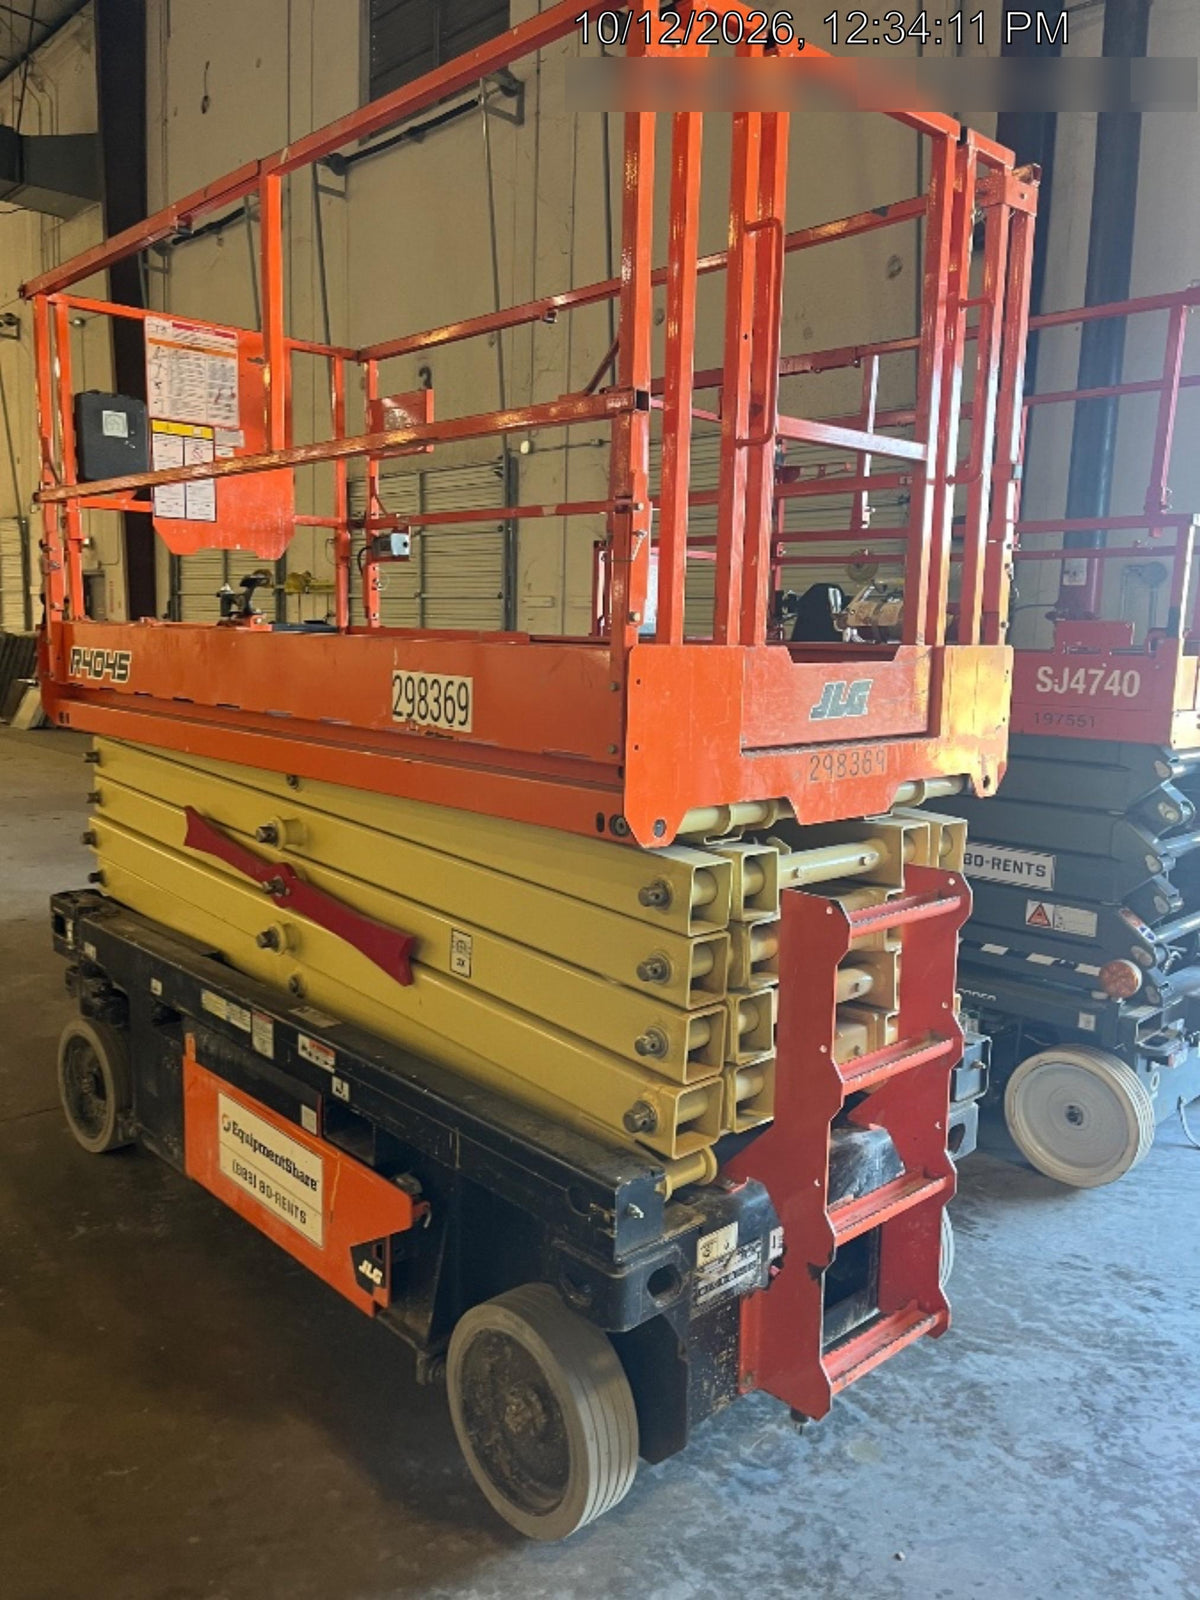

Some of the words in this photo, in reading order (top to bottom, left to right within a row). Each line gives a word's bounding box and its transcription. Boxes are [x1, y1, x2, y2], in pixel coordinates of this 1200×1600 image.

[70, 647, 131, 683] R4045
[1036, 666, 1140, 698] SJ4740
[393, 675, 469, 726] 298369
[809, 679, 873, 720] JLG
[810, 750, 885, 781] 298369
[232, 1120, 318, 1192] EquipmentShare
[359, 1259, 383, 1285] JLG
